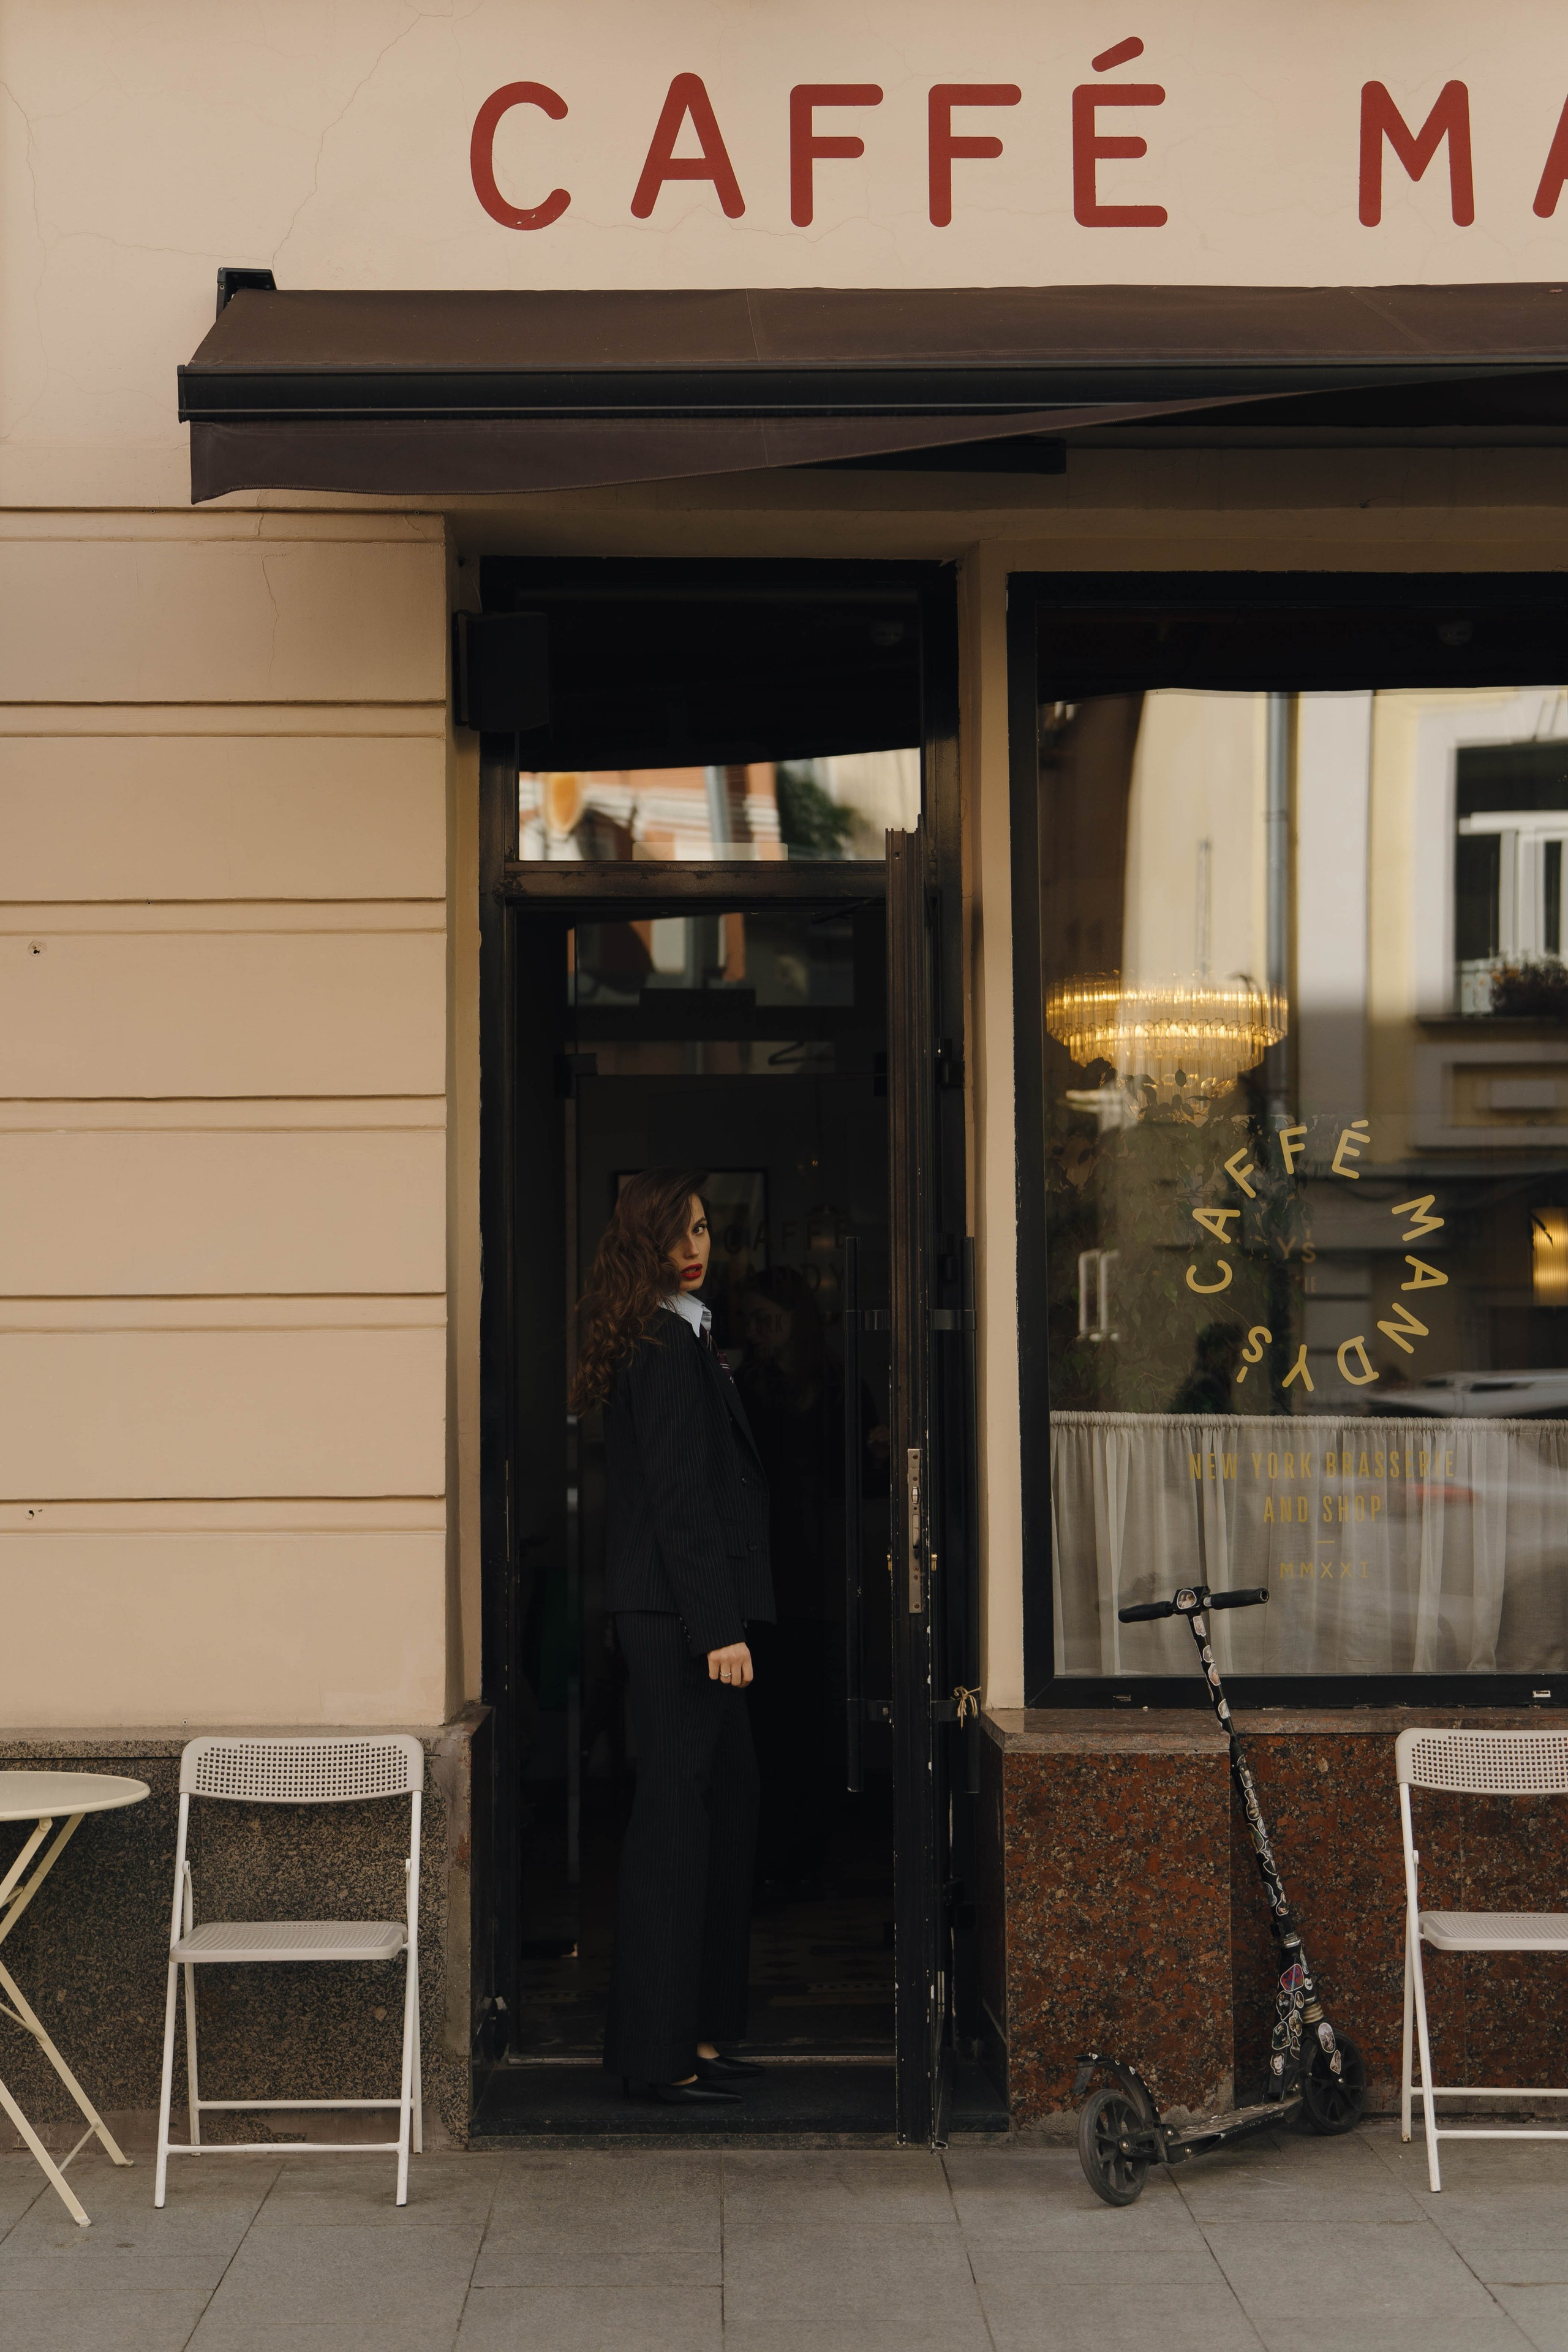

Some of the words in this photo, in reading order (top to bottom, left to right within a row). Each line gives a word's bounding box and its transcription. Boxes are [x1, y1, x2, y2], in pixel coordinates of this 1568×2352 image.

[470, 36, 1168, 231] CAFFÉ
[1185, 1119, 1371, 1294] CAFFÉ
[1235, 1194, 1449, 1392] MANDY'S
[1189, 1452, 1238, 1480] NEW
[1251, 1451, 1313, 1480] YORK
[1325, 1449, 1455, 1479] BRASSERIE
[1262, 1495, 1310, 1524] AND
[1322, 1494, 1382, 1523] SHOP
[1279, 1561, 1369, 1579] MMXXI
